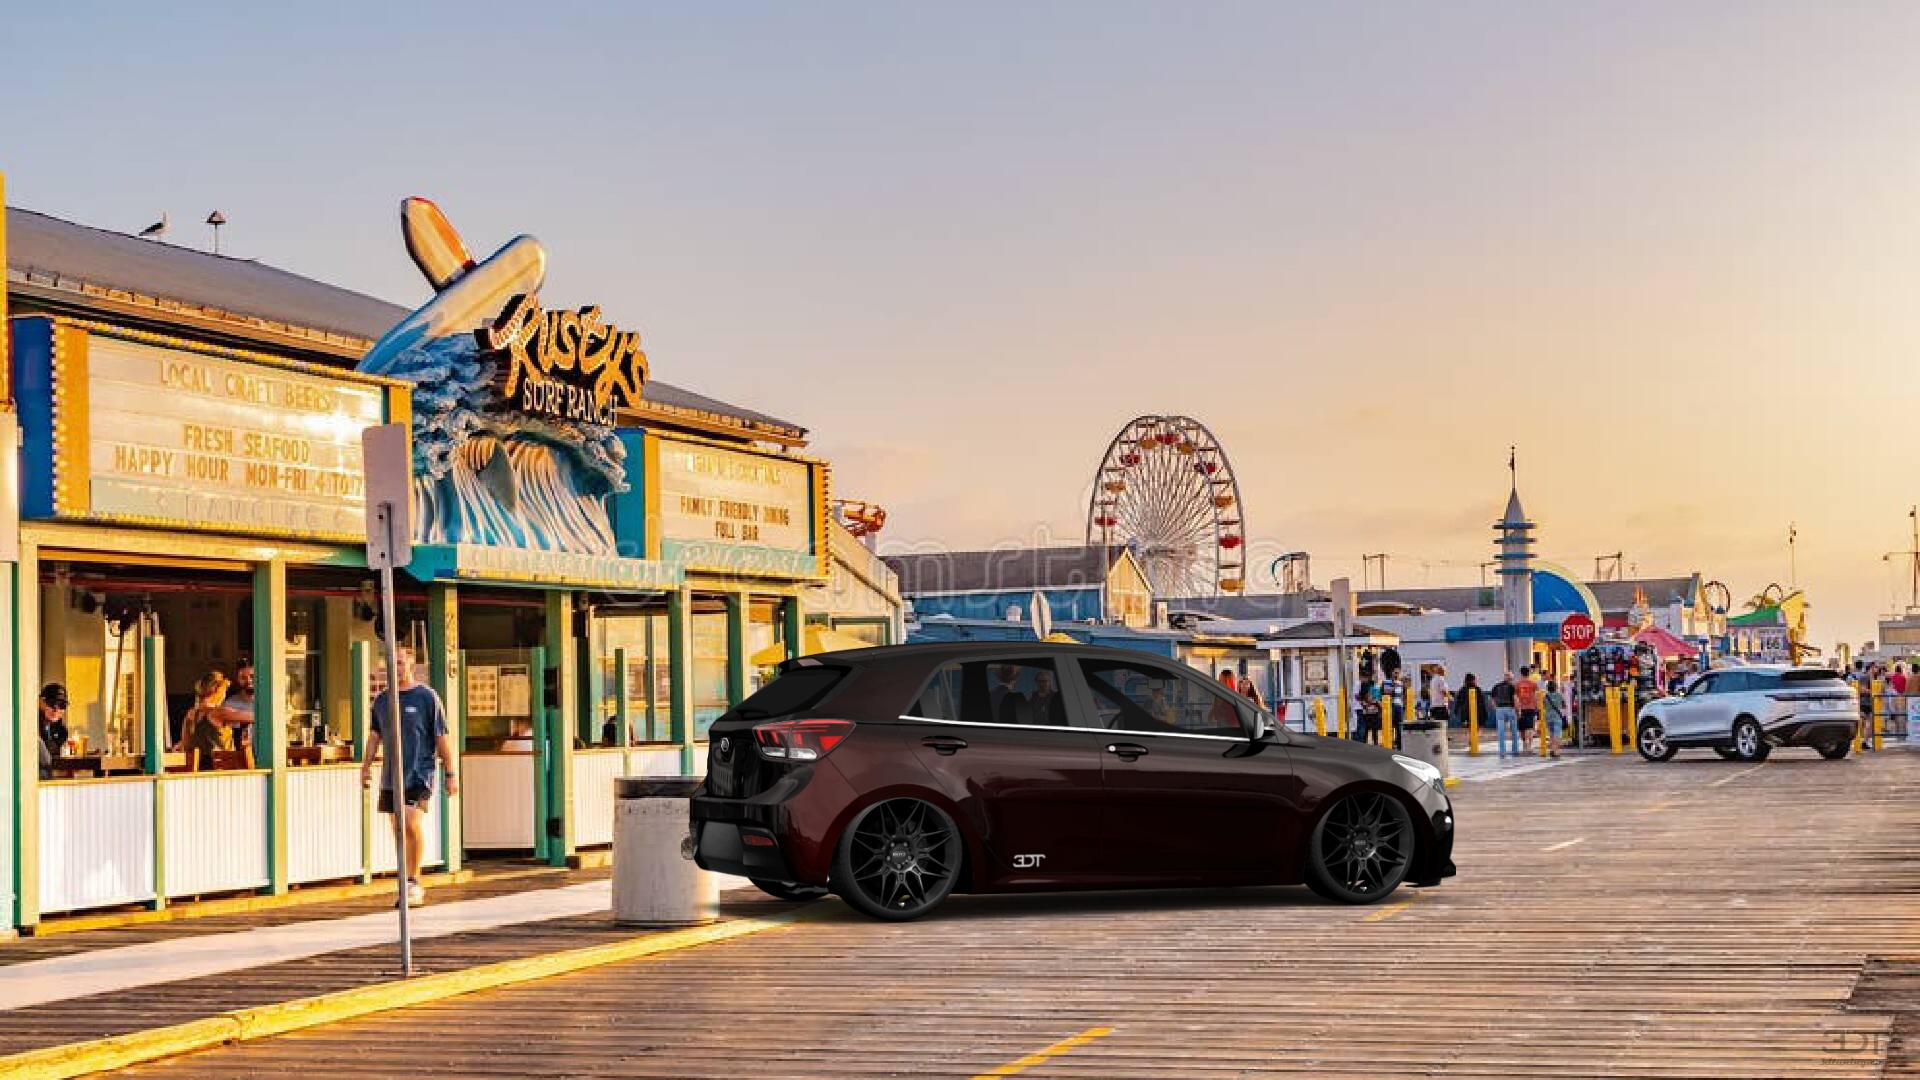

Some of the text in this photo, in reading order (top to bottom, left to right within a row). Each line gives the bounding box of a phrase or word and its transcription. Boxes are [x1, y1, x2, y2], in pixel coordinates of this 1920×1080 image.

[159, 359, 331, 412] LOCAL CRAFT BEERS
[523, 377, 564, 416] SURF
[185, 425, 309, 464] FRESH SEAFOOD
[115, 445, 173, 475] HAPPY
[187, 454, 229, 480] HOUR
[246, 462, 307, 490] MON-FRI
[680, 495, 789, 526] FAMILY FRIENDLY DINING
[715, 520, 759, 541] FULL BAR
[1563, 624, 1594, 640] STOP
